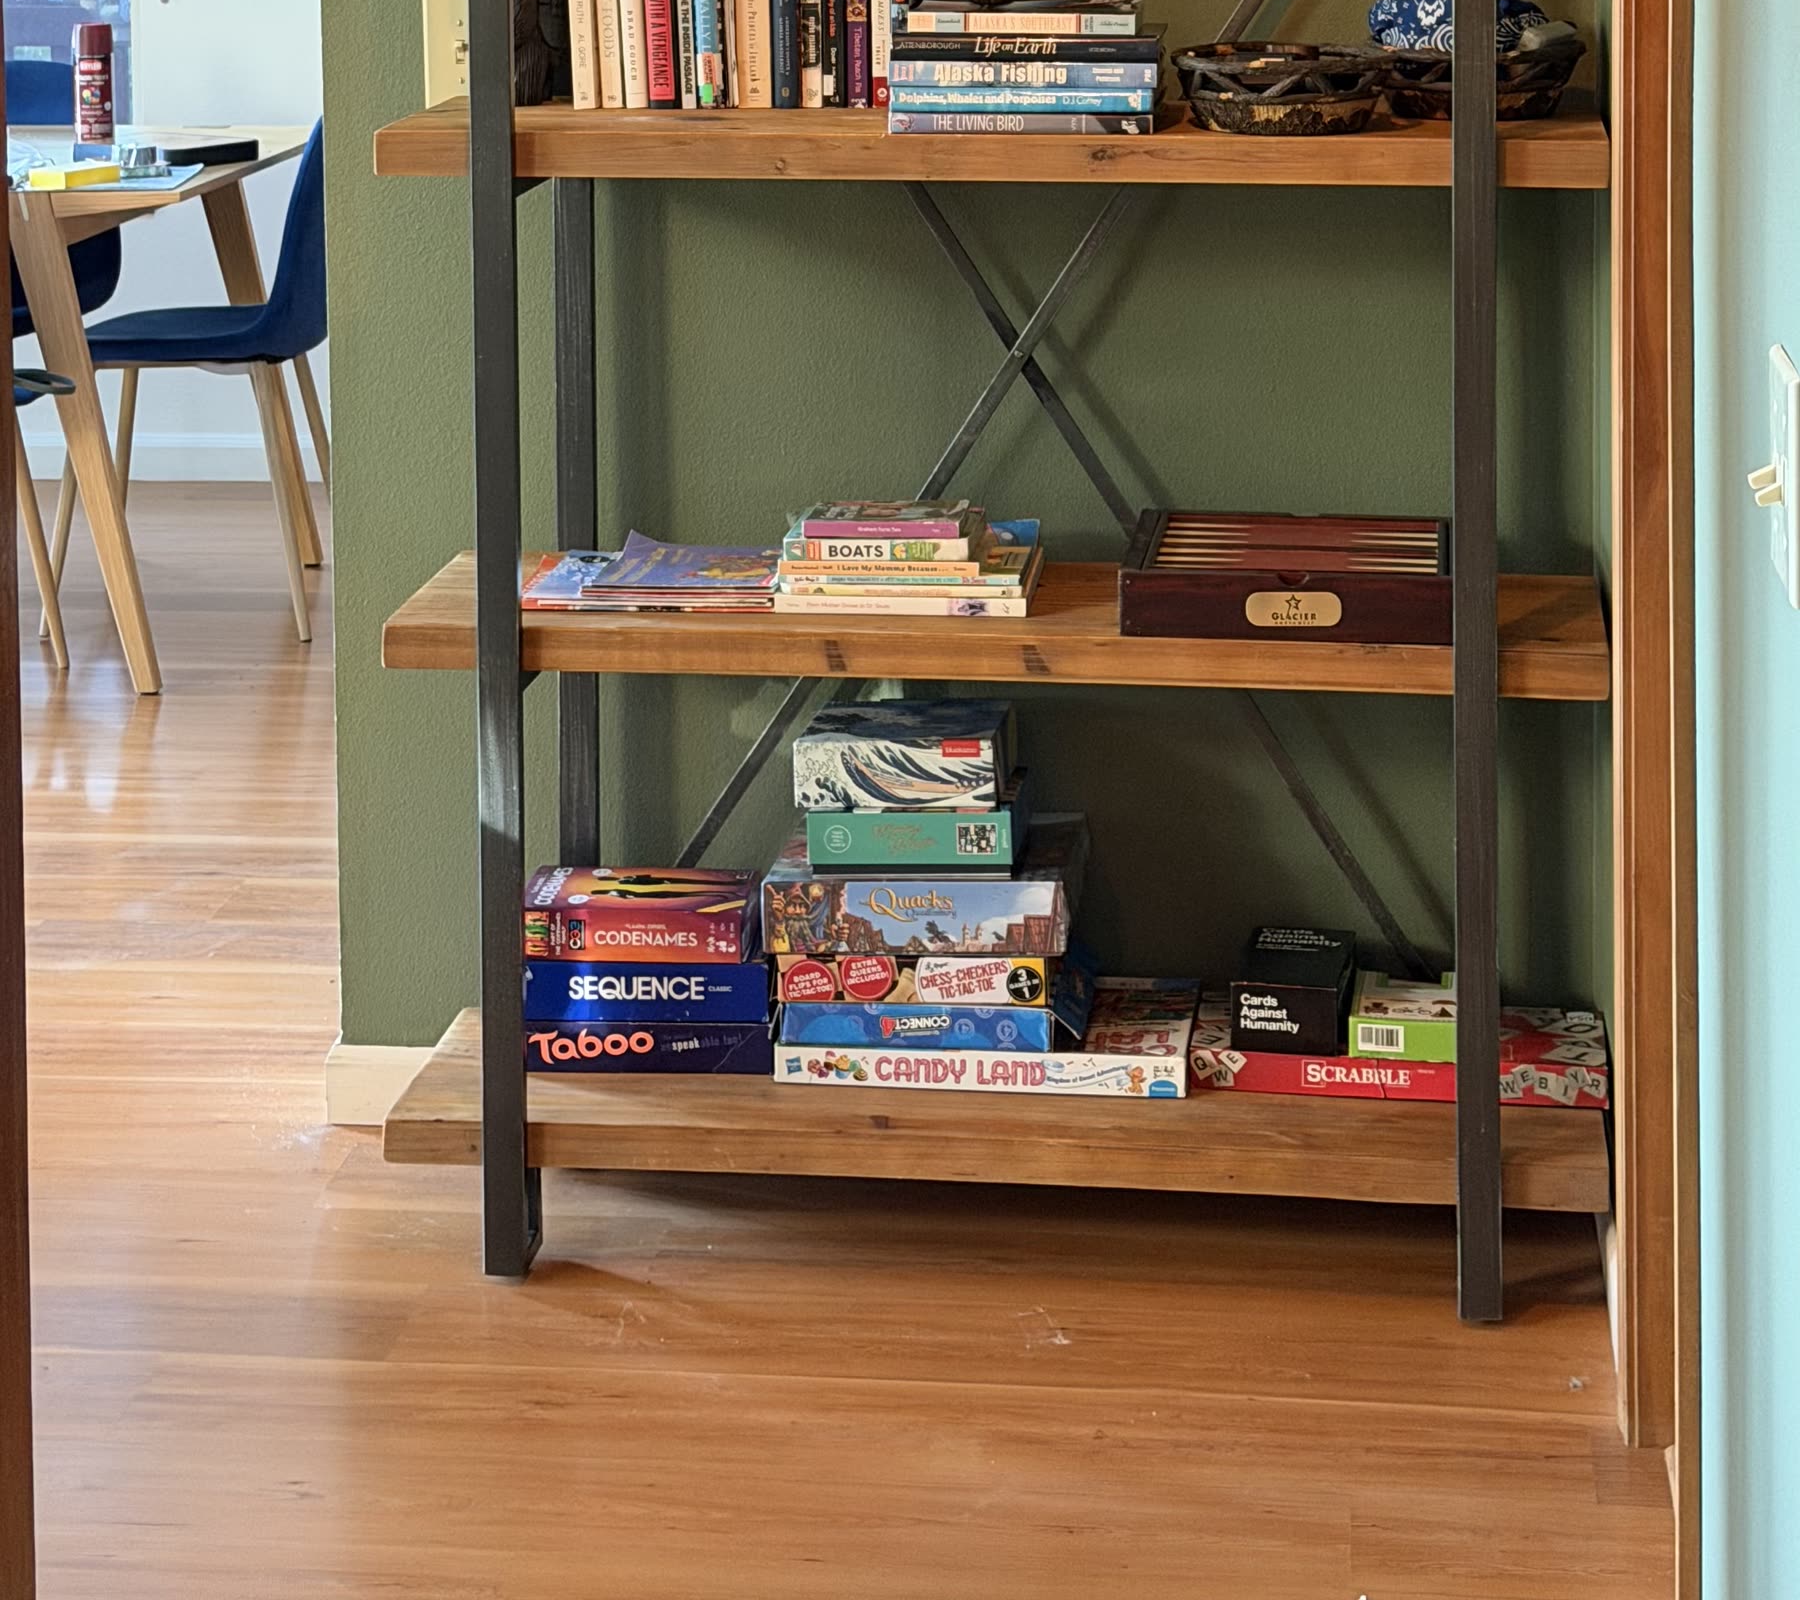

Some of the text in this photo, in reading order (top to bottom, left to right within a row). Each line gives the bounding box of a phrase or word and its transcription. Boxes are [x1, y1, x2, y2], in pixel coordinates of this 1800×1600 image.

[681, 8, 691, 24] THE
[973, 15, 1016, 31] ALASKA'S
[1019, 16, 1073, 31] SOUTHEAST
[602, 8, 616, 58] FOODS
[748, 11, 758, 41] PRINCES
[627, 10, 639, 81] BRAD GOOCH
[681, 26, 692, 54] INSIDE
[853, 27, 862, 58] Tibetan
[896, 41, 961, 50] ATTENBOROUGH
[974, 37, 1001, 58] Life
[1014, 37, 1057, 56] Earth
[578, 34, 587, 69] AL GORE
[652, 30, 670, 88] VENGEANCE
[682, 55, 694, 94] PASSAGE
[749, 51, 761, 82] IRELAND
[854, 60, 862, 80] Peach
[934, 63, 995, 82] Alaska
[1001, 63, 1068, 84] Fishing
[899, 92, 1056, 106] Dolphins, Whales and Porpoises
[932, 114, 1024, 132] THE LIVING BIRD
[828, 544, 884, 558] BOATS
[861, 565, 872, 574] My
[874, 565, 905, 574] Mommy
[1271, 612, 1317, 620] GLACIER
[534, 867, 574, 905] CODENAMES
[868, 888, 953, 922] Quacks
[594, 930, 698, 947] CODENAMES
[849, 964, 883, 978] QUEENS
[850, 958, 879, 970] EXTRA
[793, 971, 822, 983] BOARD
[846, 970, 890, 986] INCLUDED!
[919, 960, 1009, 990] CHESS-CHECKERS
[1016, 968, 1028, 982] 3
[568, 975, 733, 1001] SEQUENCE CLASSIC
[788, 977, 829, 992] FLIPS FOR
[937, 977, 997, 1000] TIC-TAC-TOE
[1009, 981, 1032, 990] GAMES
[1021, 988, 1031, 999] 1
[1240, 993, 1279, 1007] Cards
[1240, 1005, 1288, 1020] Against
[881, 1016, 896, 1038] 4
[895, 1015, 950, 1030] CONNECT
[1240, 1017, 1300, 1034] Humanity
[528, 1028, 655, 1065] Taboo
[1193, 1055, 1208, 1072] Q
[1227, 1052, 1240, 1065] E
[874, 1055, 1047, 1087] CANDY LAND
[1213, 1069, 1229, 1082] W
[1305, 1062, 1411, 1086] SCRABBLE
[1500, 1080, 1518, 1094] W
[1520, 1070, 1530, 1082] E
[1538, 1076, 1549, 1090] B
[1570, 1071, 1579, 1083] Y
[1590, 1079, 1601, 1091] R
